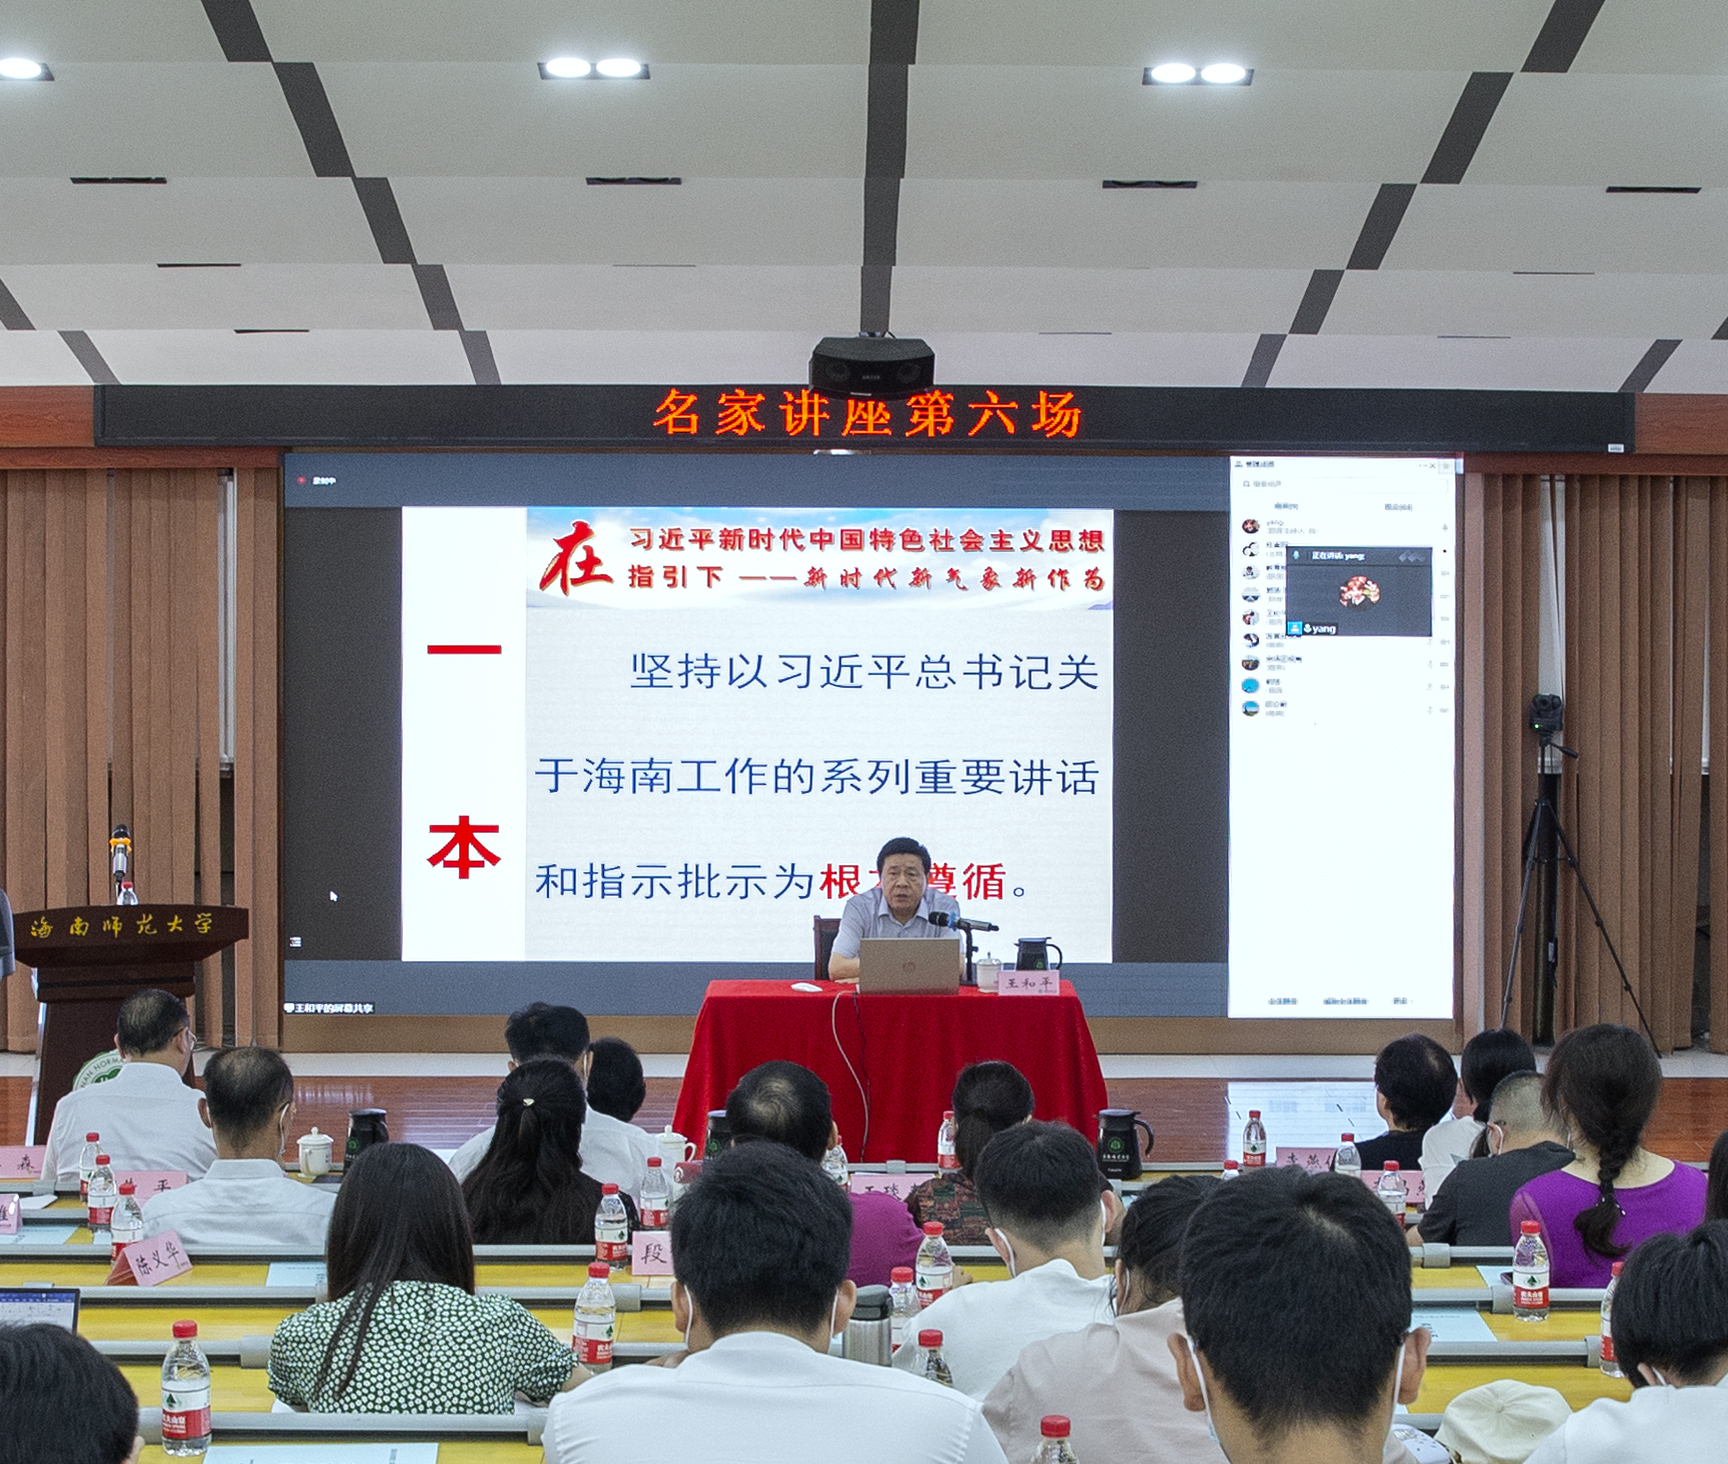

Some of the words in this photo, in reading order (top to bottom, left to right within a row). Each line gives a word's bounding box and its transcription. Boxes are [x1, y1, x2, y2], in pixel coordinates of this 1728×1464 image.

[654, 388, 1083, 438] 名家讲座第六场
[539, 520, 615, 596] 在
[629, 525, 1107, 553] 习近平新时代中国特色社会主义思想
[1312, 623, 1337, 634] yang
[629, 652, 1101, 692] 坚持以习近平总书记关
[534, 756, 1101, 798] 于海南工作的系列重要讲话
[426, 814, 502, 881] 本
[535, 861, 1035, 902] 和指示批示为根遵循。
[30, 912, 213, 939] 海南师范大学
[1005, 977, 1054, 990] 王和平
[136, 1240, 180, 1276] 陈义华
